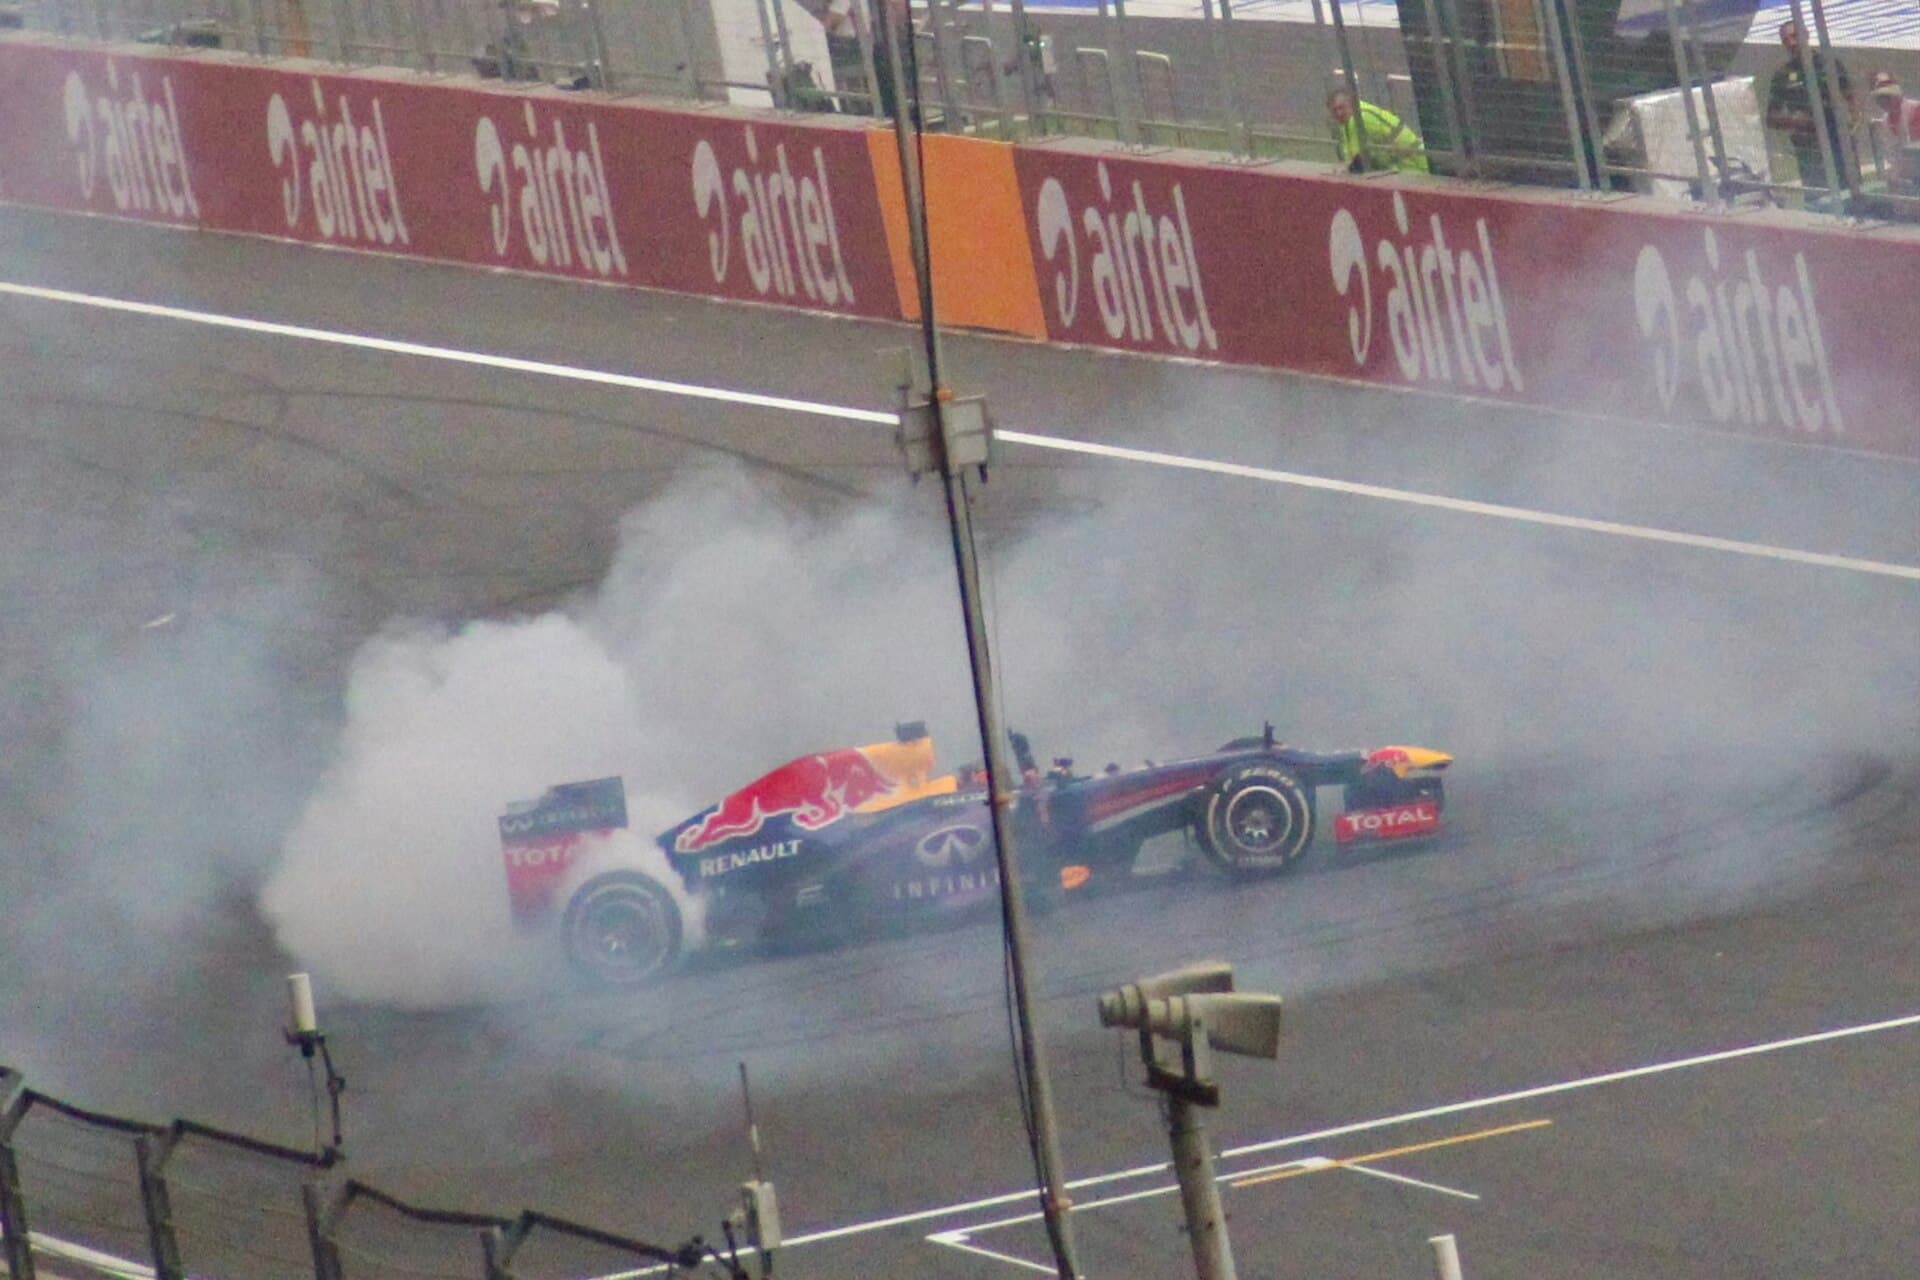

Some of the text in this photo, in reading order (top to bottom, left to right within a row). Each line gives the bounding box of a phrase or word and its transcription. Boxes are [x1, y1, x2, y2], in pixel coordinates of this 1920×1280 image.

[98, 57, 199, 218] airtel
[302, 78, 409, 245] airtel
[513, 101, 628, 276] airtel
[733, 125, 855, 304] airtel
[1084, 160, 1219, 351] airtel
[1377, 191, 1524, 393] airtel
[1687, 227, 1845, 433] airtel
[700, 839, 803, 878] RENAULT
[1346, 807, 1433, 831] TOTAL
